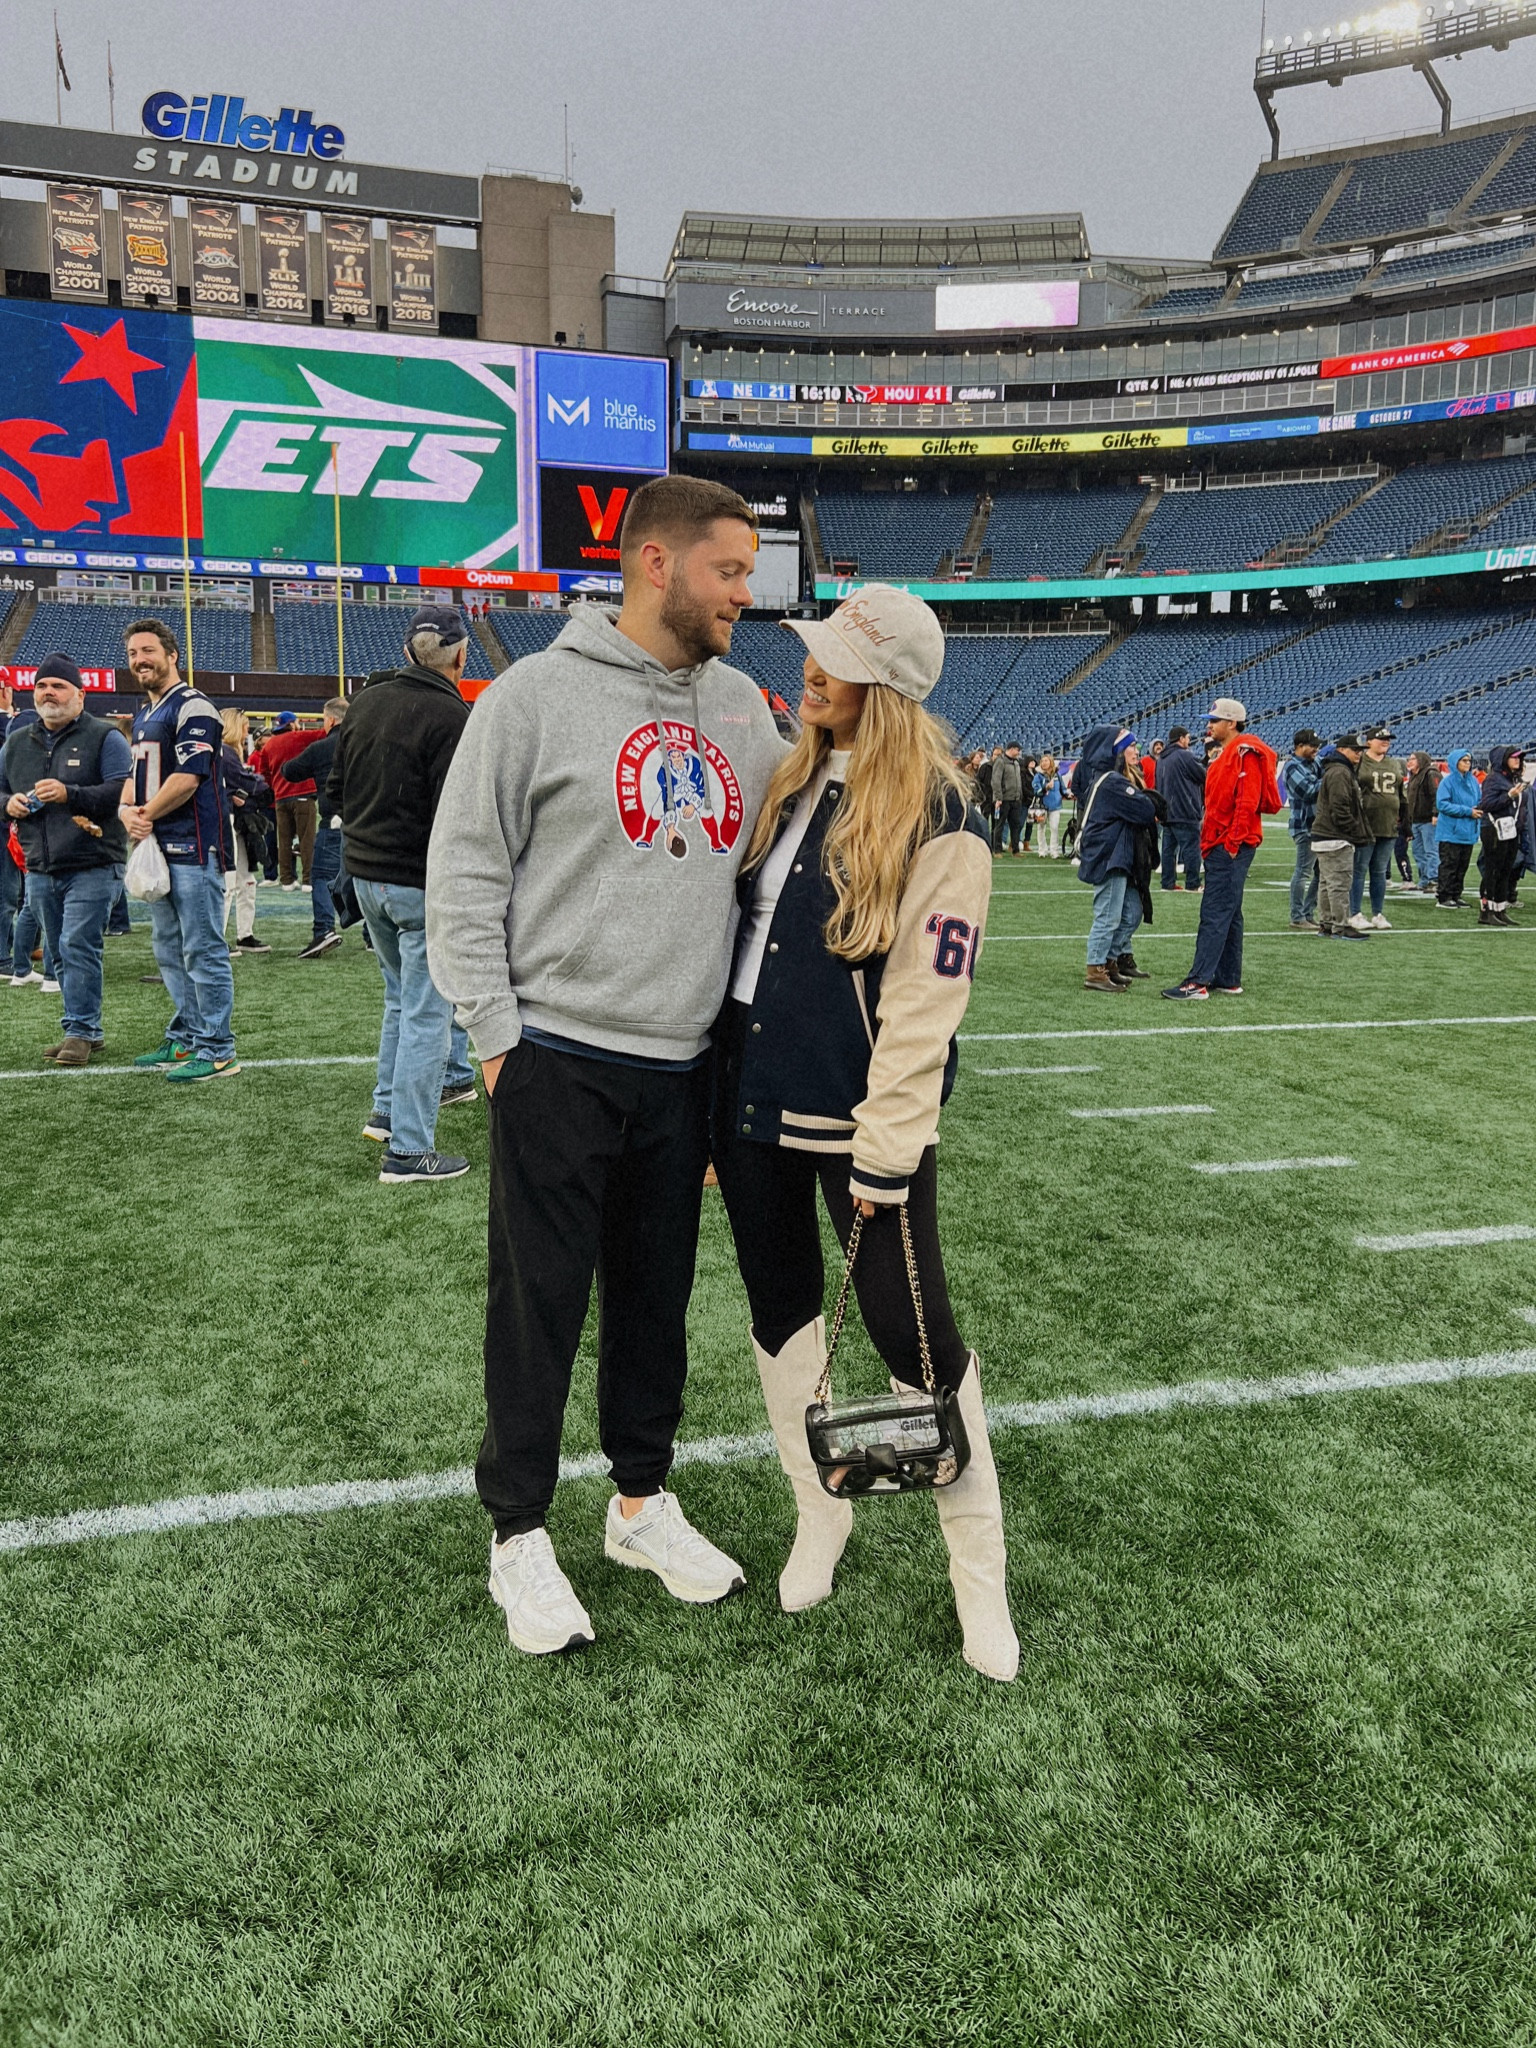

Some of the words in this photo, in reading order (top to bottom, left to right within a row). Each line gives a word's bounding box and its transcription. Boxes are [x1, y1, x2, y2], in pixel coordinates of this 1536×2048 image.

[141, 90, 346, 160] Gillette
[133, 147, 359, 196] STADIUM
[58, 275, 100, 290] 2001
[268, 271, 300, 283] XLIX
[127, 282, 171, 297] 2003
[195, 289, 240, 304] 2004
[265, 296, 305, 311] 2014
[331, 302, 369, 316] 2016
[726, 288, 819, 315] Encore
[395, 308, 432, 320] 2018
[830, 306, 886, 316] TERRACE
[733, 316, 771, 328] BOSTON
[773, 318, 811, 329] HARBOR
[1351, 359, 1379, 372] BANK
[1381, 357, 1395, 367] OF
[1396, 349, 1445, 365] AMERICA
[1125, 380, 1149, 393] QTR
[1150, 378, 1160, 391] 4
[1186, 376, 1192, 388] 4
[1193, 374, 1216, 387] YARD
[1217, 369, 1263, 385] RECEPTION
[1264, 368, 1276, 380] BY
[733, 383, 753, 397] NE
[768, 384, 785, 398] 21
[801, 386, 842, 401] 16:10
[884, 388, 914, 401] HOU
[924, 388, 941, 401] 41
[1513, 388, 1536, 409] NEW
[604, 397, 638, 417] blue
[604, 414, 657, 432] mantis
[1331, 414, 1357, 430] GAME
[1369, 410, 1401, 425] OCTOBER
[1402, 409, 1413, 421] 27
[748, 440, 775, 450] Mutual
[831, 438, 889, 456] Gillette
[922, 438, 979, 456] Gillette
[1012, 433, 1070, 453] Gillette
[1102, 431, 1161, 449] Gillette
[25, 551, 77, 565] GEICO
[579, 545, 621, 560] verizo
[85, 554, 137, 568] GEICO
[202, 560, 252, 573] GEICO
[259, 562, 308, 575] GEICO
[467, 570, 514, 586] Optum
[842, 600, 897, 647] England
[81, 671, 100, 688] 41
[621, 762, 638, 812] NEW
[703, 740, 741, 823] ATRIOTS
[1371, 771, 1396, 794] 12
